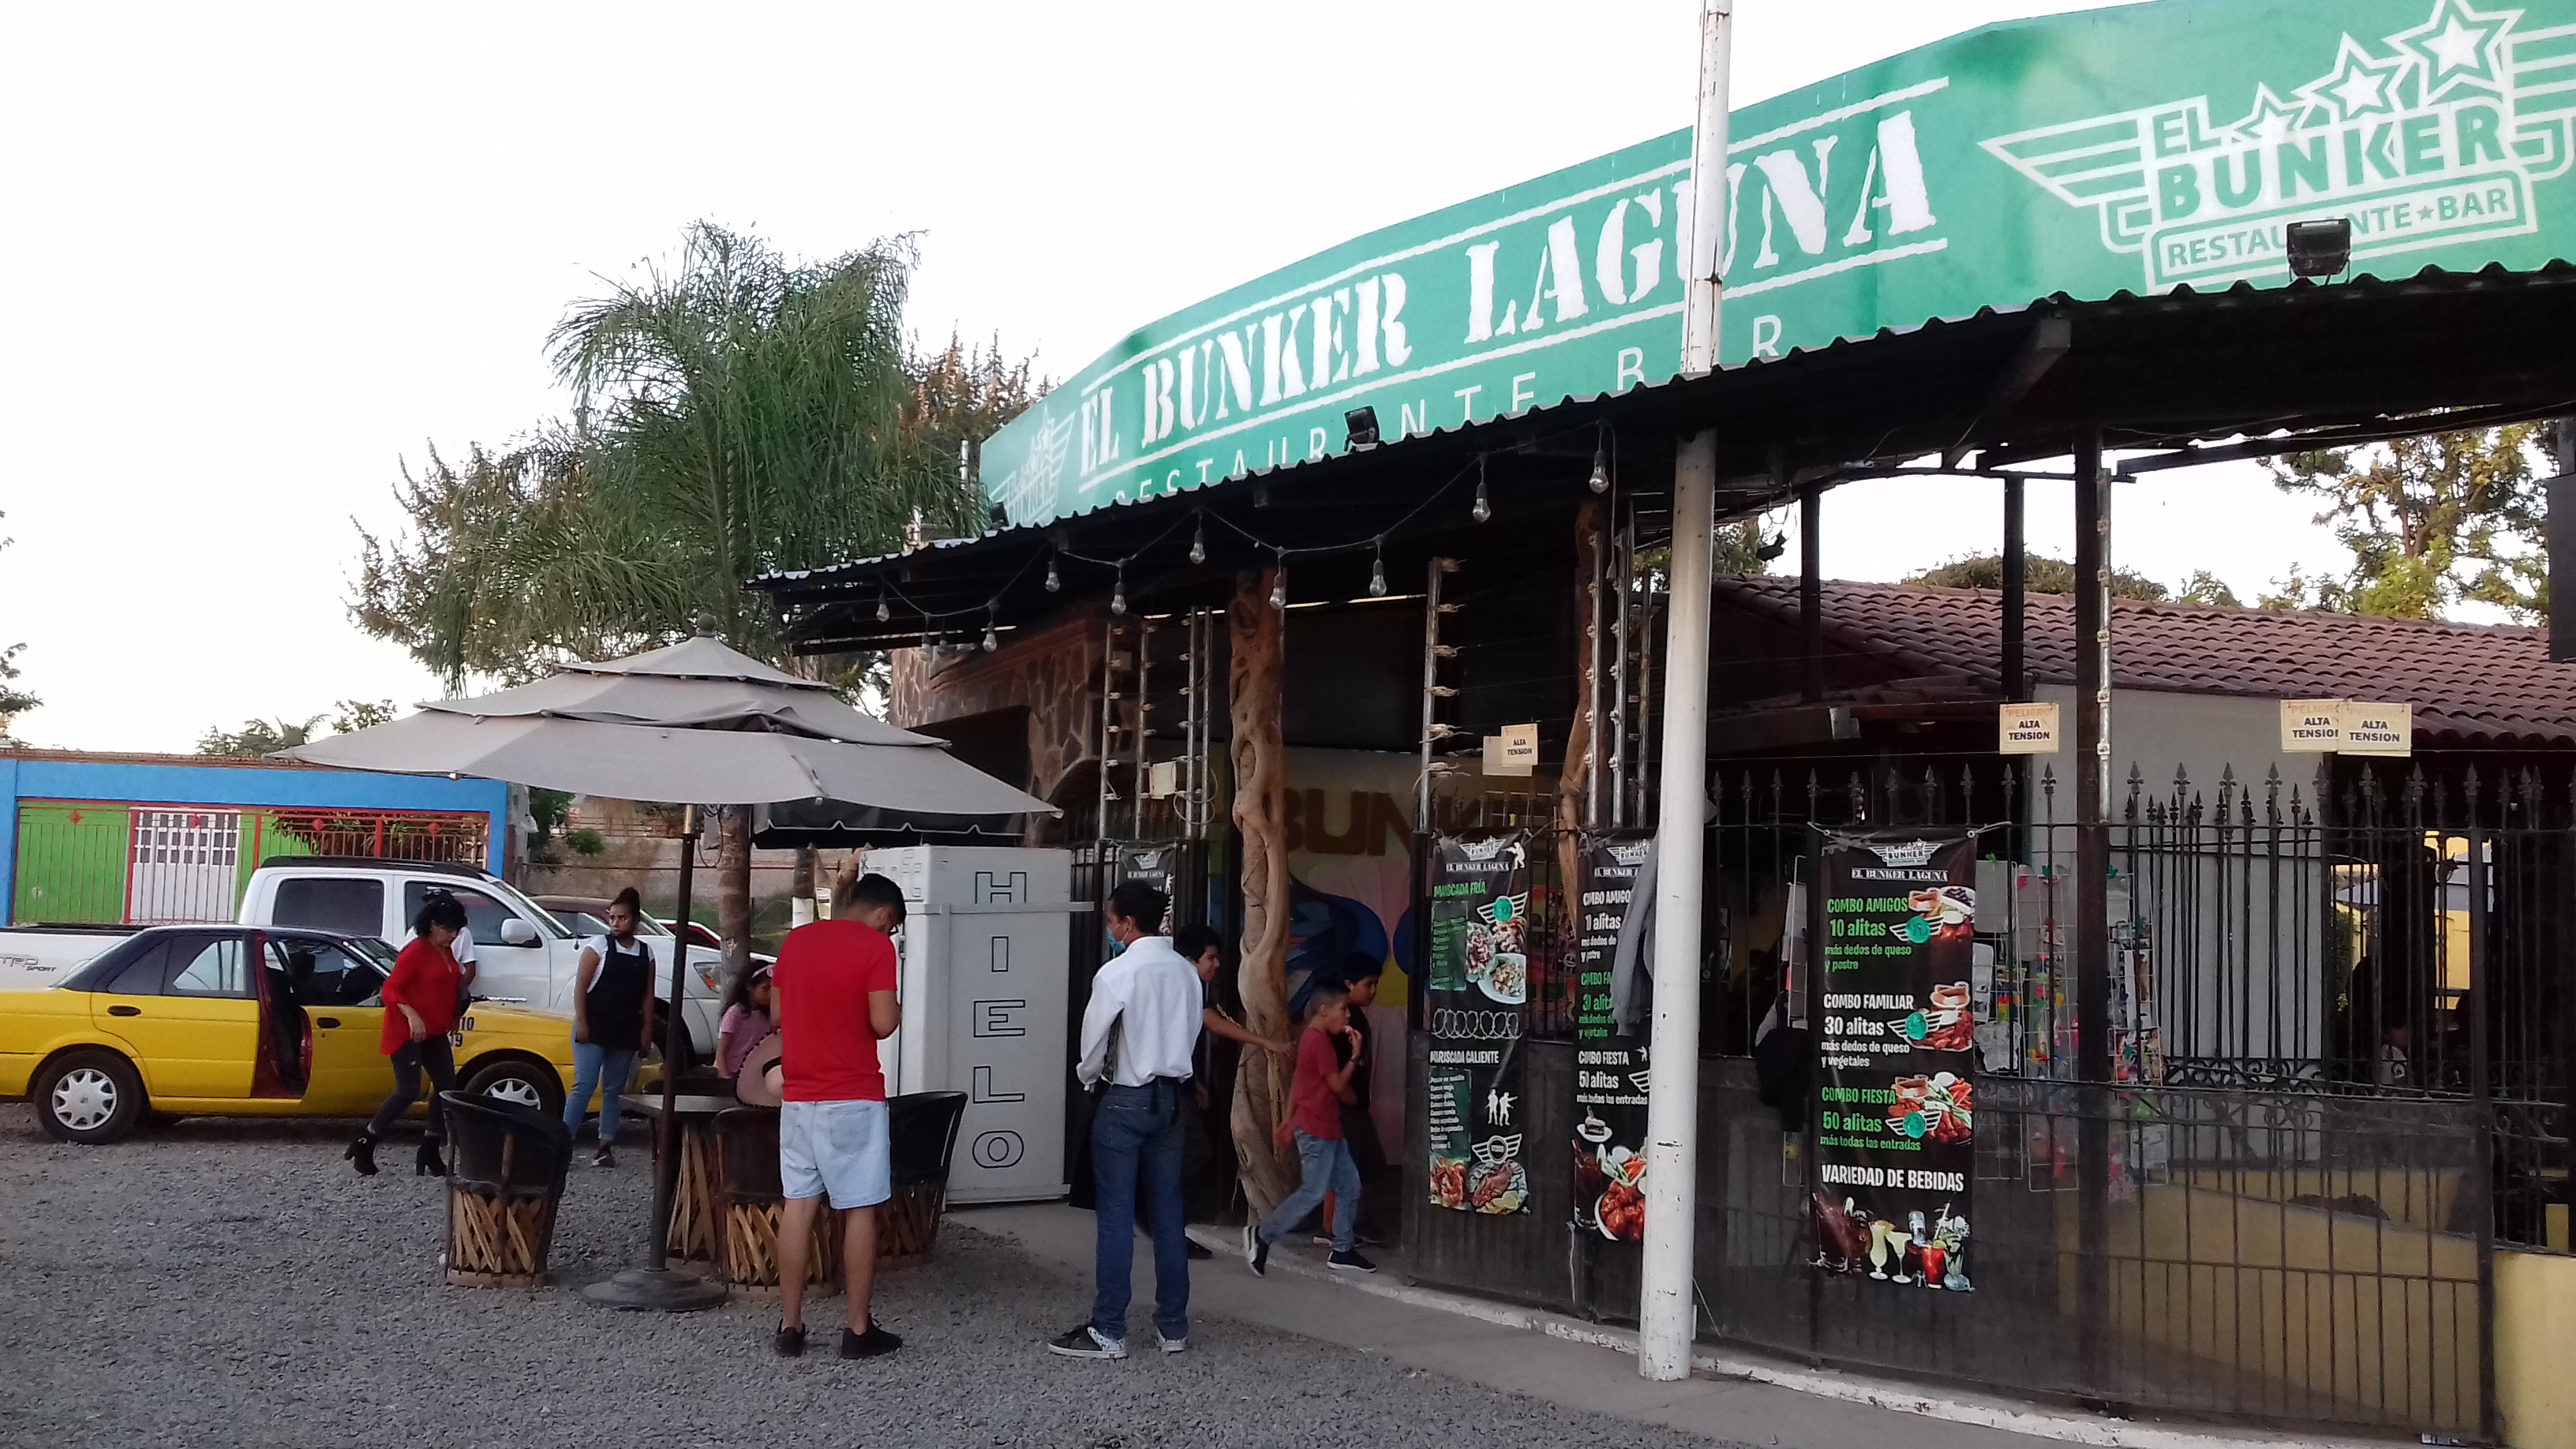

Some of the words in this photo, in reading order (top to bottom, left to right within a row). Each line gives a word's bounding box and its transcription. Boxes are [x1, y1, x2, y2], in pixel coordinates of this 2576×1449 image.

[2152, 107, 2222, 159] EL
[2158, 107, 2507, 221] BUNKER
[2167, 203, 2413, 268] RESTAUNTE
[2437, 188, 2510, 222] BAR
[1080, 386, 1119, 477] EL
[1142, 272, 1412, 449] BUNKER
[1465, 110, 1937, 344] LAGUNA
[1116, 371, 1537, 499] ESTAURNTE
[1617, 315, 1783, 391] BR
[2018, 720, 2041, 729] ALTA
[2304, 717, 2331, 726] ALTA
[2361, 720, 2388, 730] ALTA
[2008, 731, 2050, 741] TENSION
[2349, 732, 2401, 743] TENSION
[1507, 747, 1533, 756] TENSION
[1606, 889, 1631, 904] AMIGO
[1827, 898, 1863, 912] COMBO
[1866, 897, 1908, 912] AMIGOS
[1593, 912, 1622, 930] alitas
[1829, 918, 1844, 937] 10
[1847, 918, 1887, 937] alitas
[1844, 943, 1870, 955] dedos
[1871, 943, 1883, 955] de
[1885, 945, 1912, 958] queso
[1825, 960, 1831, 972] y
[1833, 959, 1859, 972] postre
[1823, 994, 1861, 1009] COMBO
[1863, 994, 1915, 1010] FAMILIAR
[972, 871, 1027, 1169] HIELO
[1824, 1016, 1844, 1035] 30
[1846, 1017, 1885, 1036] alitas
[1821, 1039, 1840, 1051] más
[1841, 1039, 1868, 1052] dedos
[1869, 1040, 1881, 1053] de
[1882, 1043, 1910, 1056] queso
[1466, 1050, 1500, 1064] CALIENTE
[1602, 1050, 1630, 1066] FIESTA
[1821, 1056, 1827, 1068] y
[1828, 1054, 1870, 1069] vegetales
[1590, 1070, 1619, 1088] alitas
[1616, 1093, 1648, 1105] entradas
[1822, 1086, 1859, 1103] COMBO
[1861, 1088, 1896, 1105] FIESTA
[1822, 1110, 1840, 1130] 50
[1842, 1112, 1882, 1133] alitas
[1820, 1133, 1839, 1145] más
[1840, 1134, 1865, 1148] todas
[1866, 1136, 1879, 1149] las
[1880, 1138, 1922, 1151] entradas
[1822, 1164, 1884, 1186] VARIEDAD
[1887, 1168, 1905, 1189] DE
[1908, 1170, 1964, 1192] BEBIDAS
